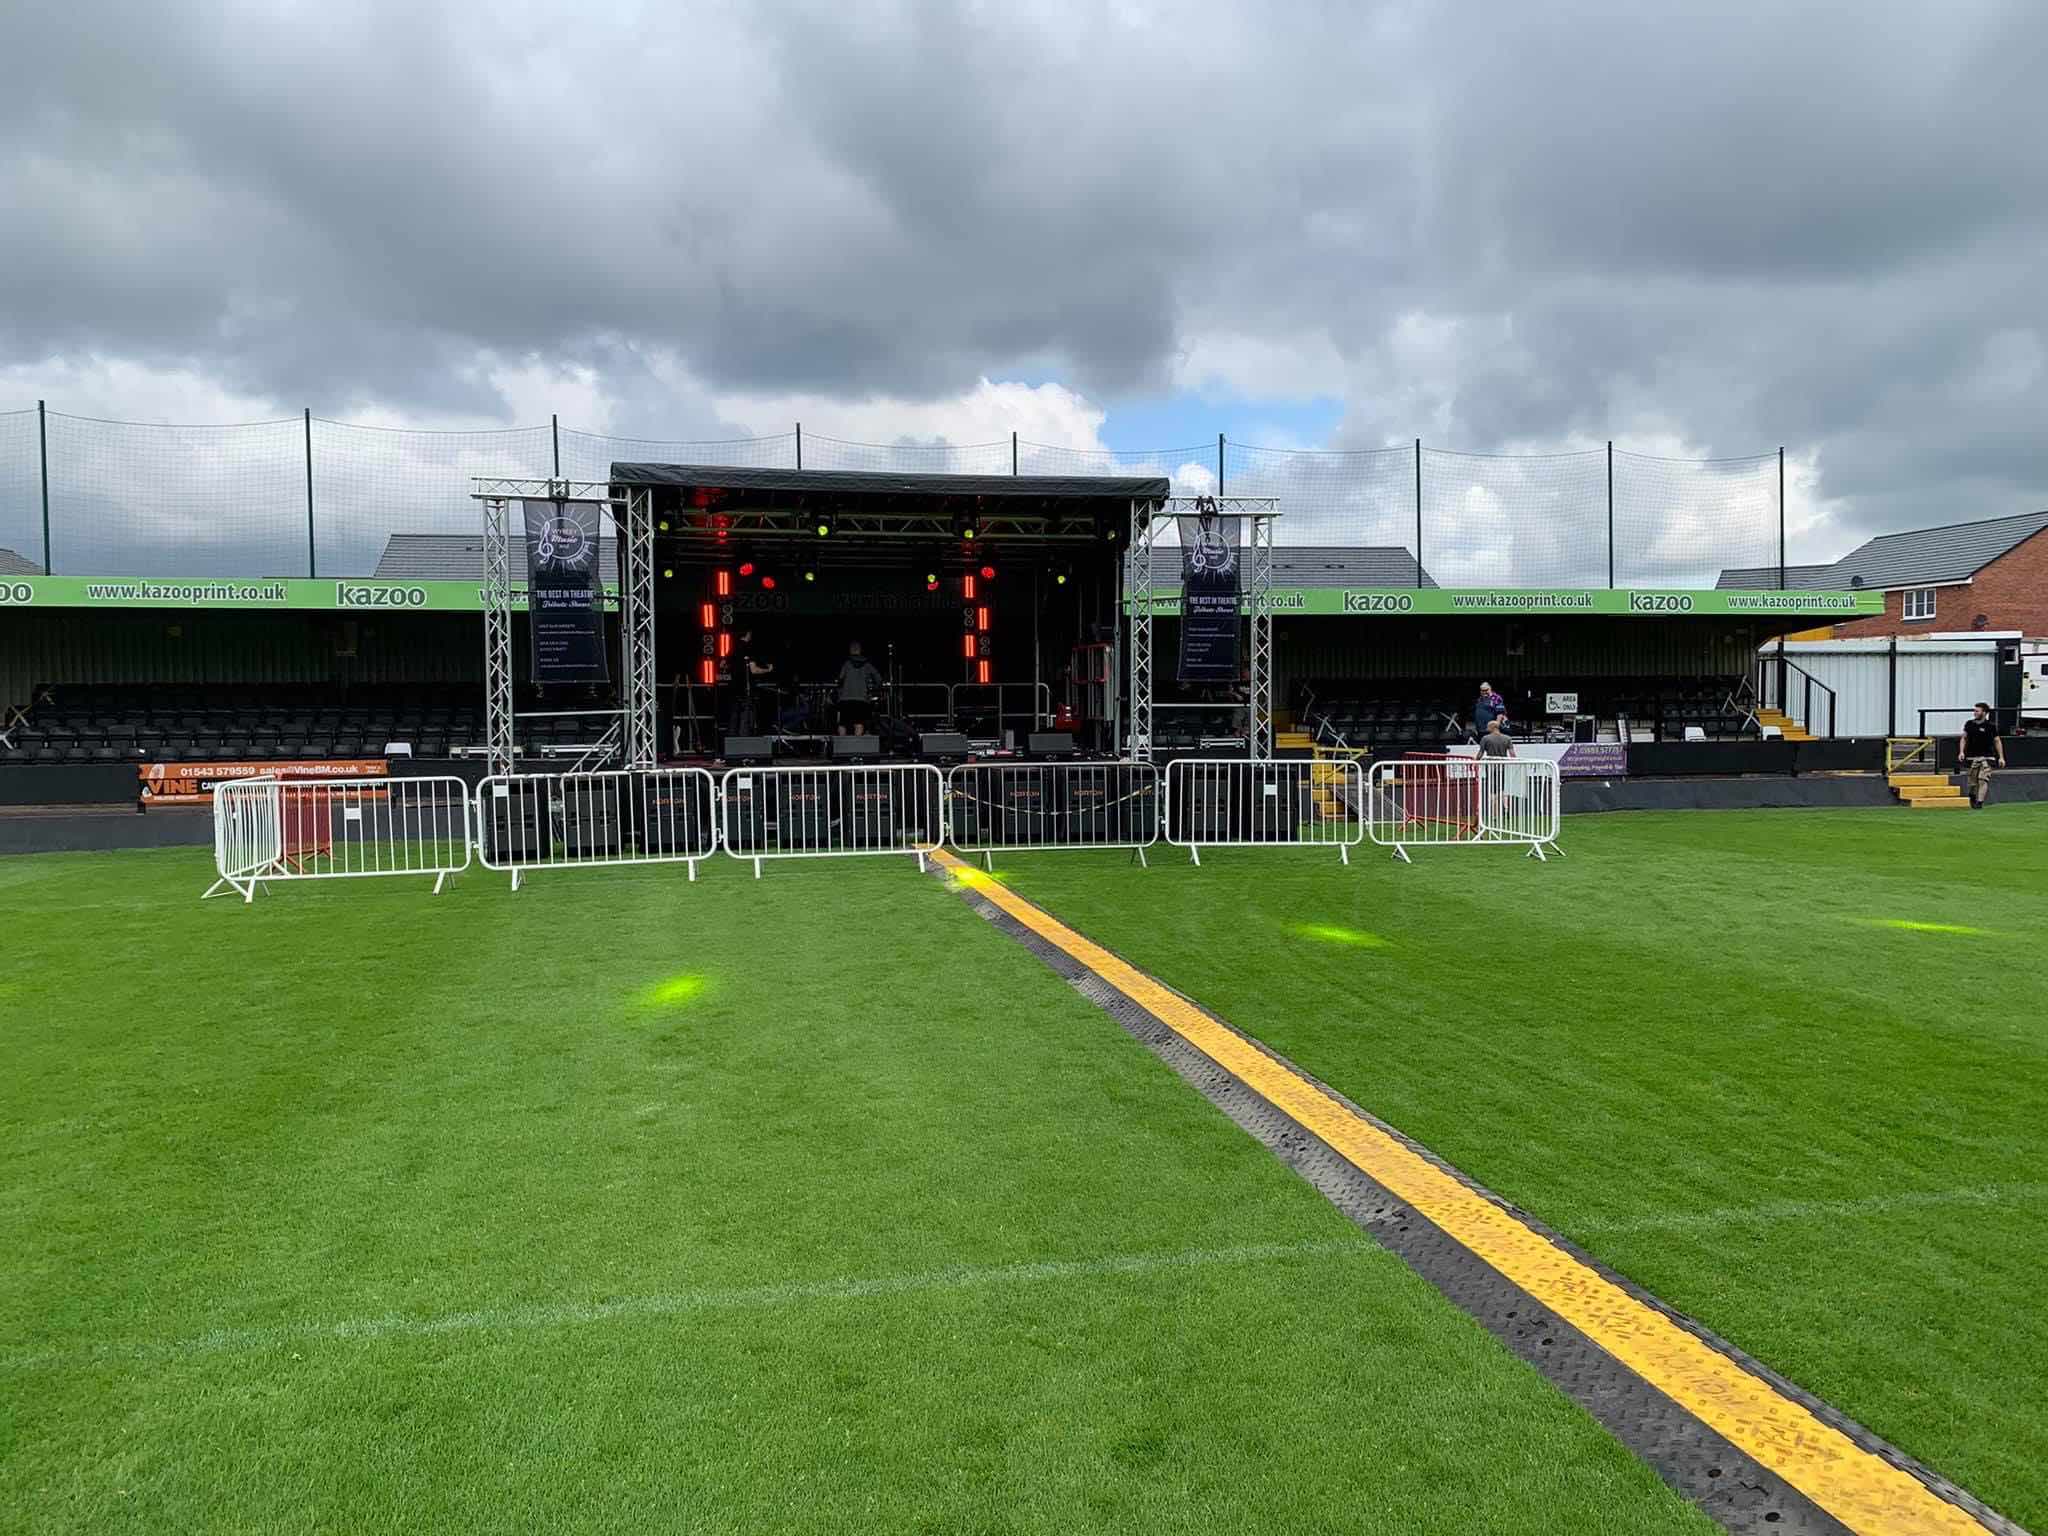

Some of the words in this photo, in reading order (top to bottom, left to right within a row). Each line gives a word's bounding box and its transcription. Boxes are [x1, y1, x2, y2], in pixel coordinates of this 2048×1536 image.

[88, 582, 286, 604] www.kazooprint.co.uk
[336, 582, 426, 607] kazoo
[536, 590, 547, 598] THE
[548, 590, 562, 598] BEST
[1343, 590, 1414, 612] kazoo
[1453, 592, 1593, 610] www.kazooprint.co.uk
[1628, 591, 1693, 612] kazoo
[1728, 593, 1856, 610] www.kazooprint.co.uk
[1562, 703, 1577, 711] ONLY
[180, 768, 214, 777] 01543
[148, 779, 198, 794] VINE
